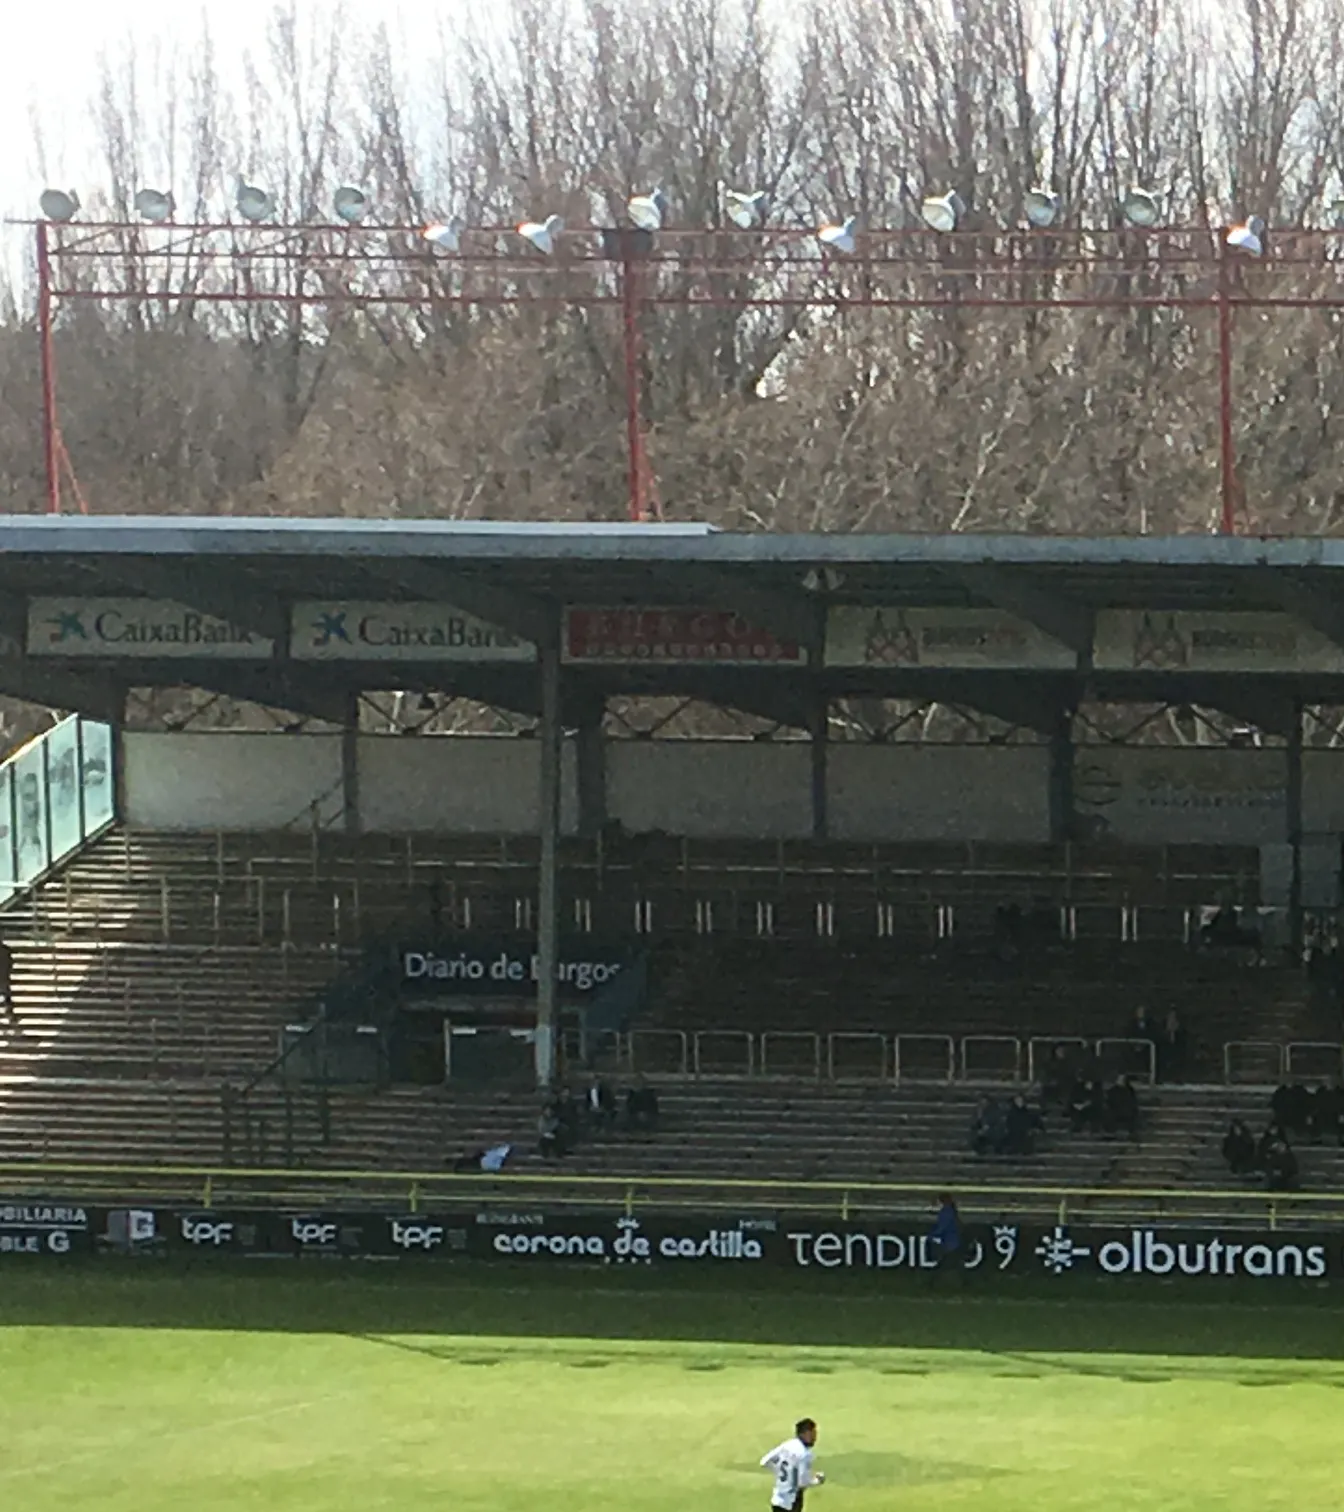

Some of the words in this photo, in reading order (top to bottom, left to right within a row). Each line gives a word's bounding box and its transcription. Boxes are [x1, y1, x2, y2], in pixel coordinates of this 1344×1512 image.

[404, 951, 484, 979] Diario
[491, 953, 525, 980] de
[47, 1230, 71, 1253] G
[493, 1230, 604, 1255] corona
[612, 1226, 651, 1256] de
[659, 1228, 763, 1259] castilla
[994, 1235, 1017, 1270] 9
